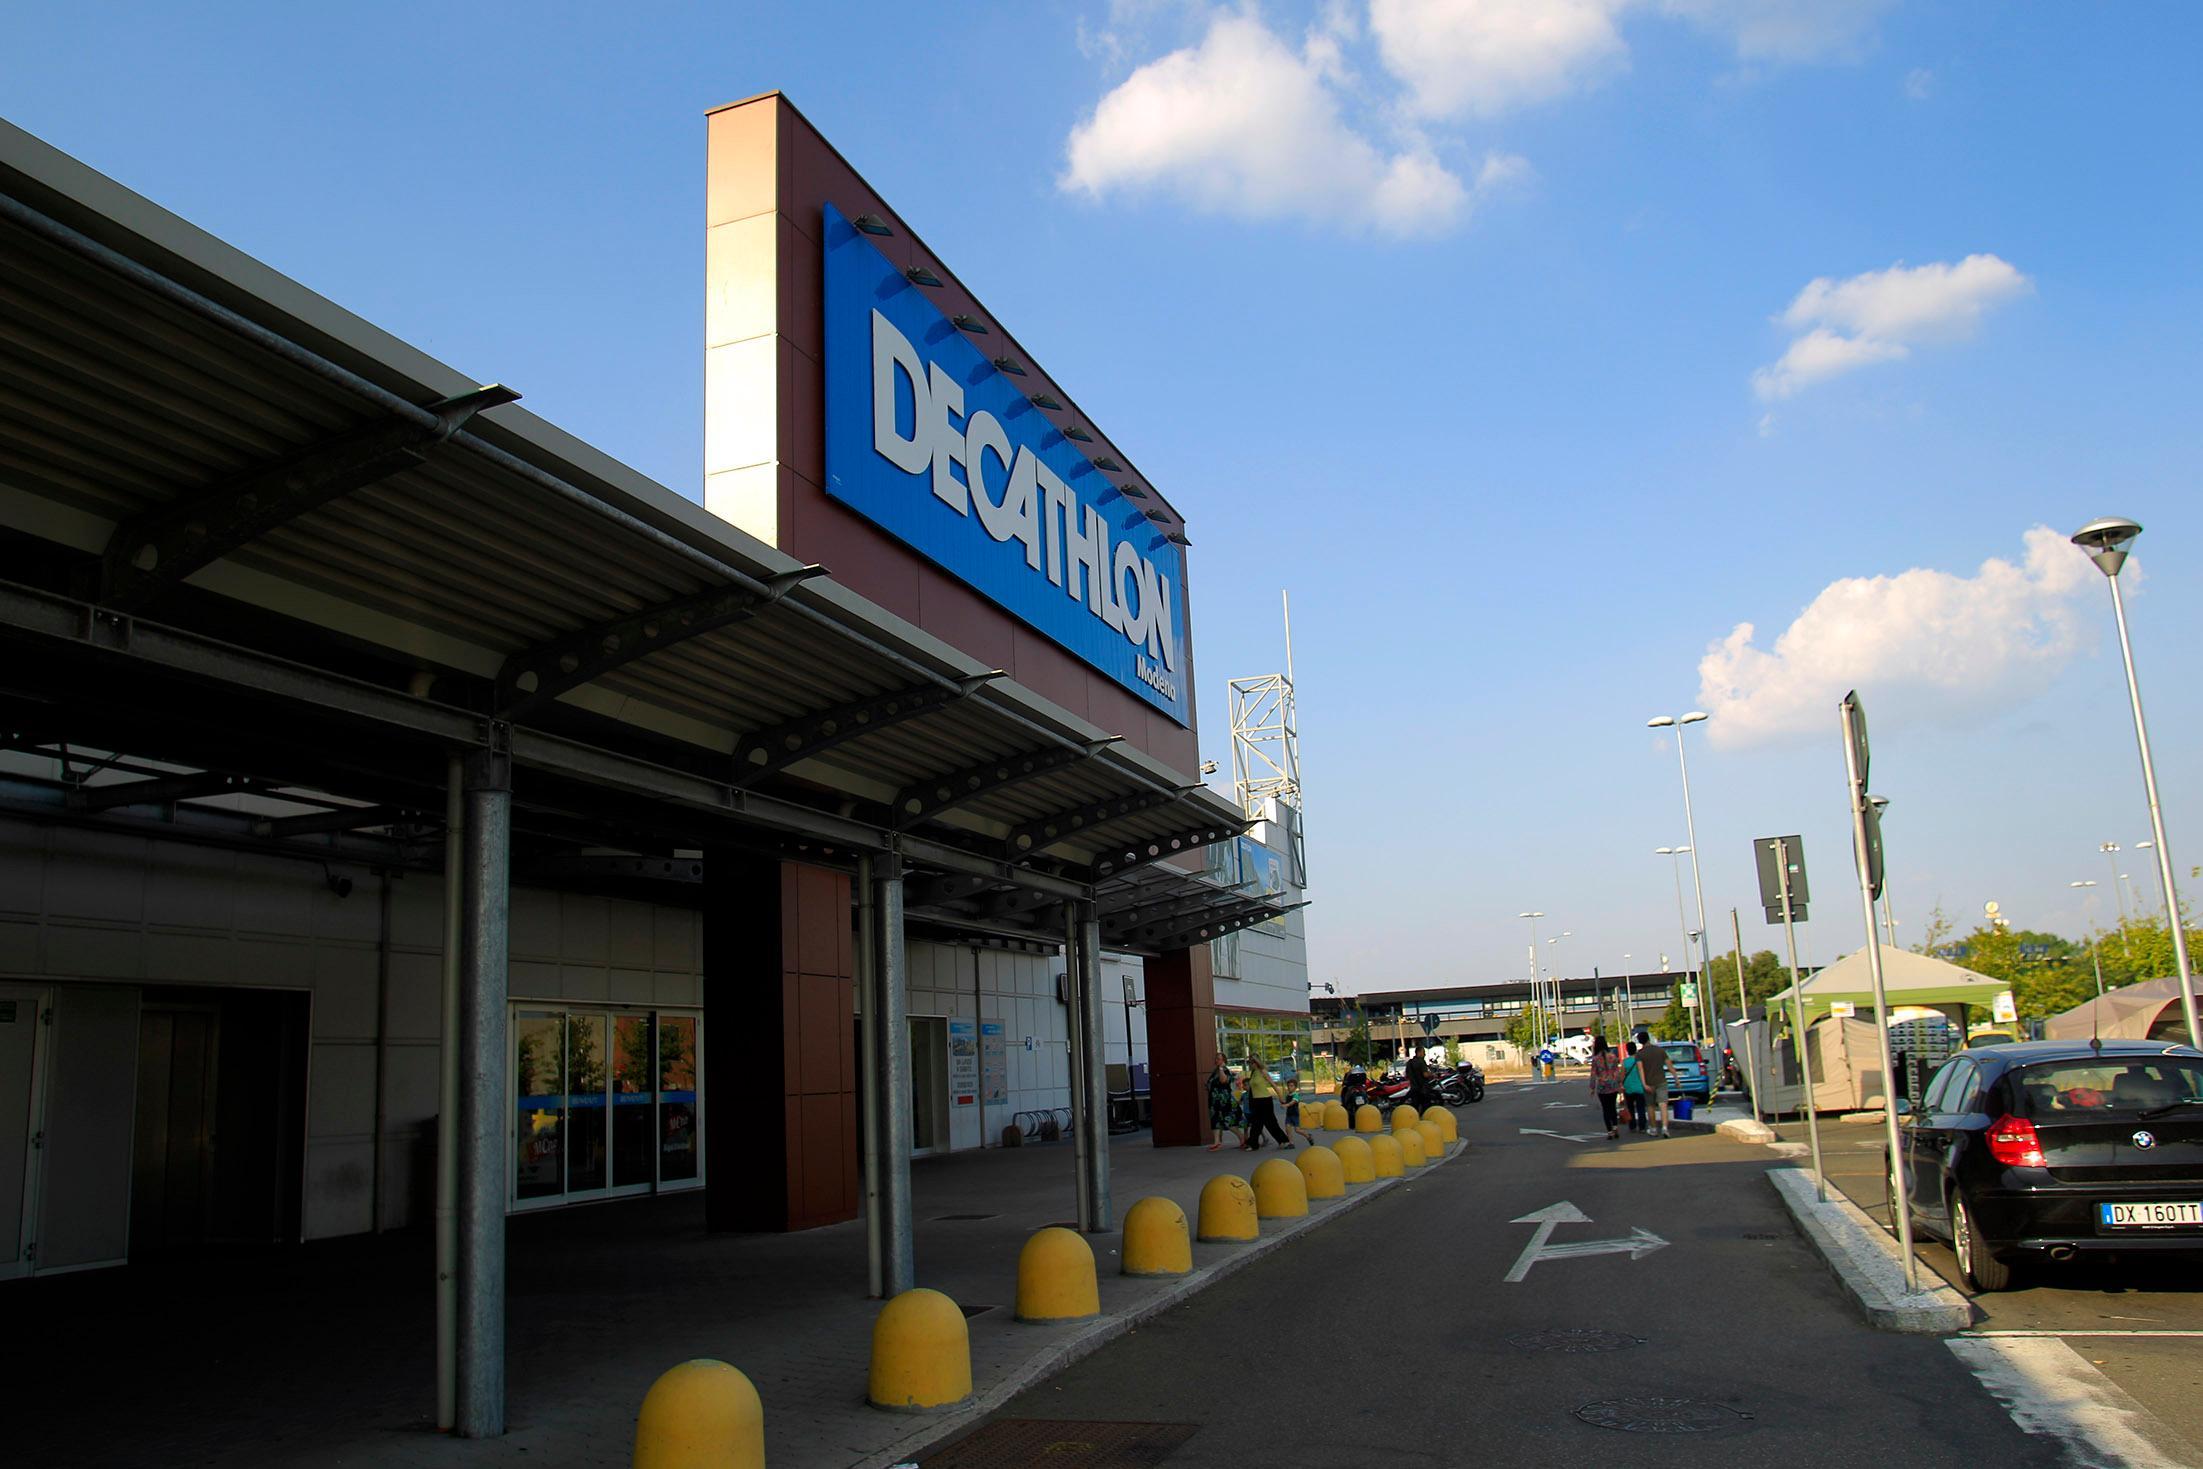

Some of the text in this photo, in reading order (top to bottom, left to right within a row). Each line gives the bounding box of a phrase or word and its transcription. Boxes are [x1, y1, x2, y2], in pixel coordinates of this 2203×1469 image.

[872, 308, 1174, 672] DECATHLON
[1137, 654, 1176, 702] Modena
[2114, 1205, 2198, 1223] DX 160TT
